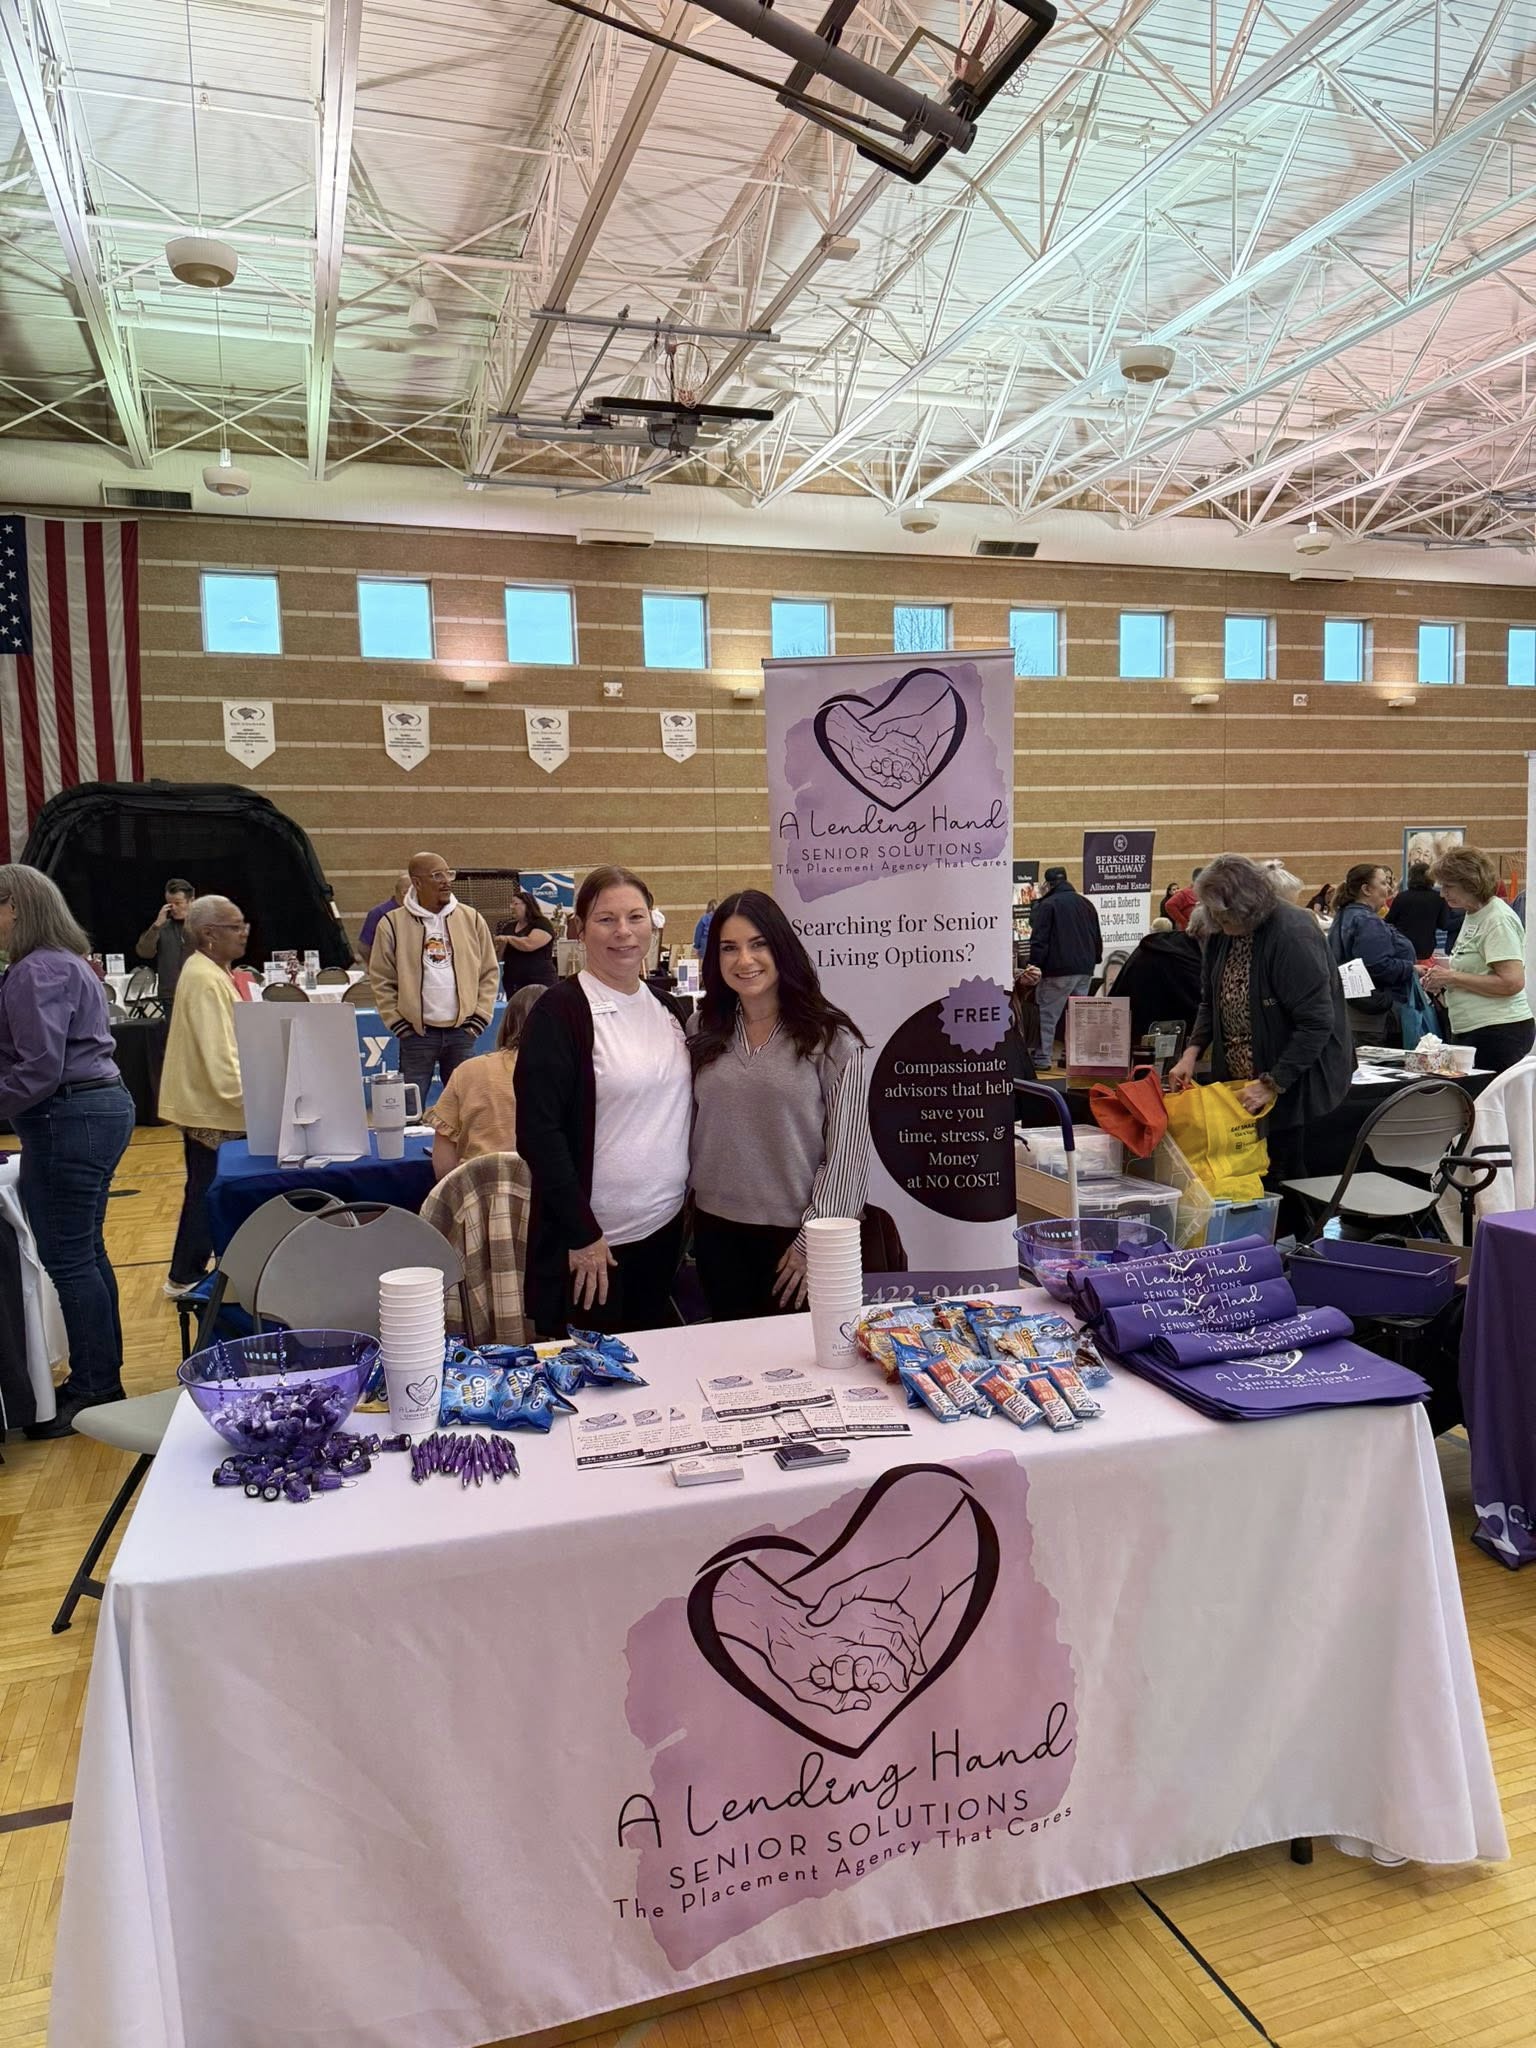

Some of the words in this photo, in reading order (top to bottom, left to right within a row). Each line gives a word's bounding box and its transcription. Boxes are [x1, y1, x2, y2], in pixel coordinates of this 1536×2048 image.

[779, 811, 800, 840] A
[810, 804, 926, 843] Lending
[932, 799, 1005, 833] Hand
[801, 847, 870, 861] SENIOR
[877, 842, 983, 859] SOLUTIONS
[1095, 854, 1146, 865] BERKSHIRE
[776, 864, 800, 875] The
[807, 863, 875, 874] Placement
[881, 861, 928, 873] Agency
[935, 858, 965, 869] That
[970, 857, 1008, 868] Cares
[1098, 864, 1144, 874] HATHAWAY
[1090, 883, 1116, 892] Alliance
[1116, 882, 1129, 890] Real
[1131, 881, 1151, 890] Estate
[1117, 896, 1141, 908] Roberts
[791, 916, 892, 938] Searching
[897, 914, 928, 933] for
[933, 911, 998, 932] Senior
[817, 948, 879, 969] Living
[885, 943, 975, 968] Options?
[954, 1007, 1001, 1023] FREE
[894, 1059, 1007, 1077] Compassionate
[884, 1083, 948, 1098] advisors
[952, 1081, 983, 1097] that
[986, 1079, 1014, 1096] help
[920, 1108, 954, 1120] save
[957, 1108, 985, 1122] you
[899, 1129, 937, 1144] time,
[941, 1130, 990, 1143] stress,
[993, 1126, 1006, 1140] &
[928, 1152, 979, 1167] Money
[907, 1175, 922, 1189] at
[926, 1174, 950, 1188] NO
[954, 1171, 1000, 1188] COST!
[1125, 1273, 1140, 1289] A
[1143, 1263, 1207, 1287] Lending
[1208, 1254, 1253, 1279] Hand
[1143, 1288, 1179, 1300] SENIOR
[1182, 1279, 1243, 1297] SOLUTIONS
[1142, 1303, 1158, 1319] A
[1156, 1301, 1219, 1319] Lending
[1218, 1285, 1264, 1310] Hand
[1160, 1321, 1195, 1331] SENIOR
[1305, 1363, 1355, 1377] Hand
[471, 1378, 486, 1408] OREO
[617, 1793, 662, 1848] A
[687, 1751, 917, 1836] Lending
[932, 1702, 1073, 1781] Hand
[669, 1834, 807, 1889] SENIOR
[826, 1789, 1029, 1853] SOLUTIONS
[613, 1898, 664, 1919] The
[682, 1865, 818, 1914] Placement
[834, 1839, 921, 1878] Agency
[936, 1826, 992, 1849] That
[1007, 1805, 1072, 1837] Cares
